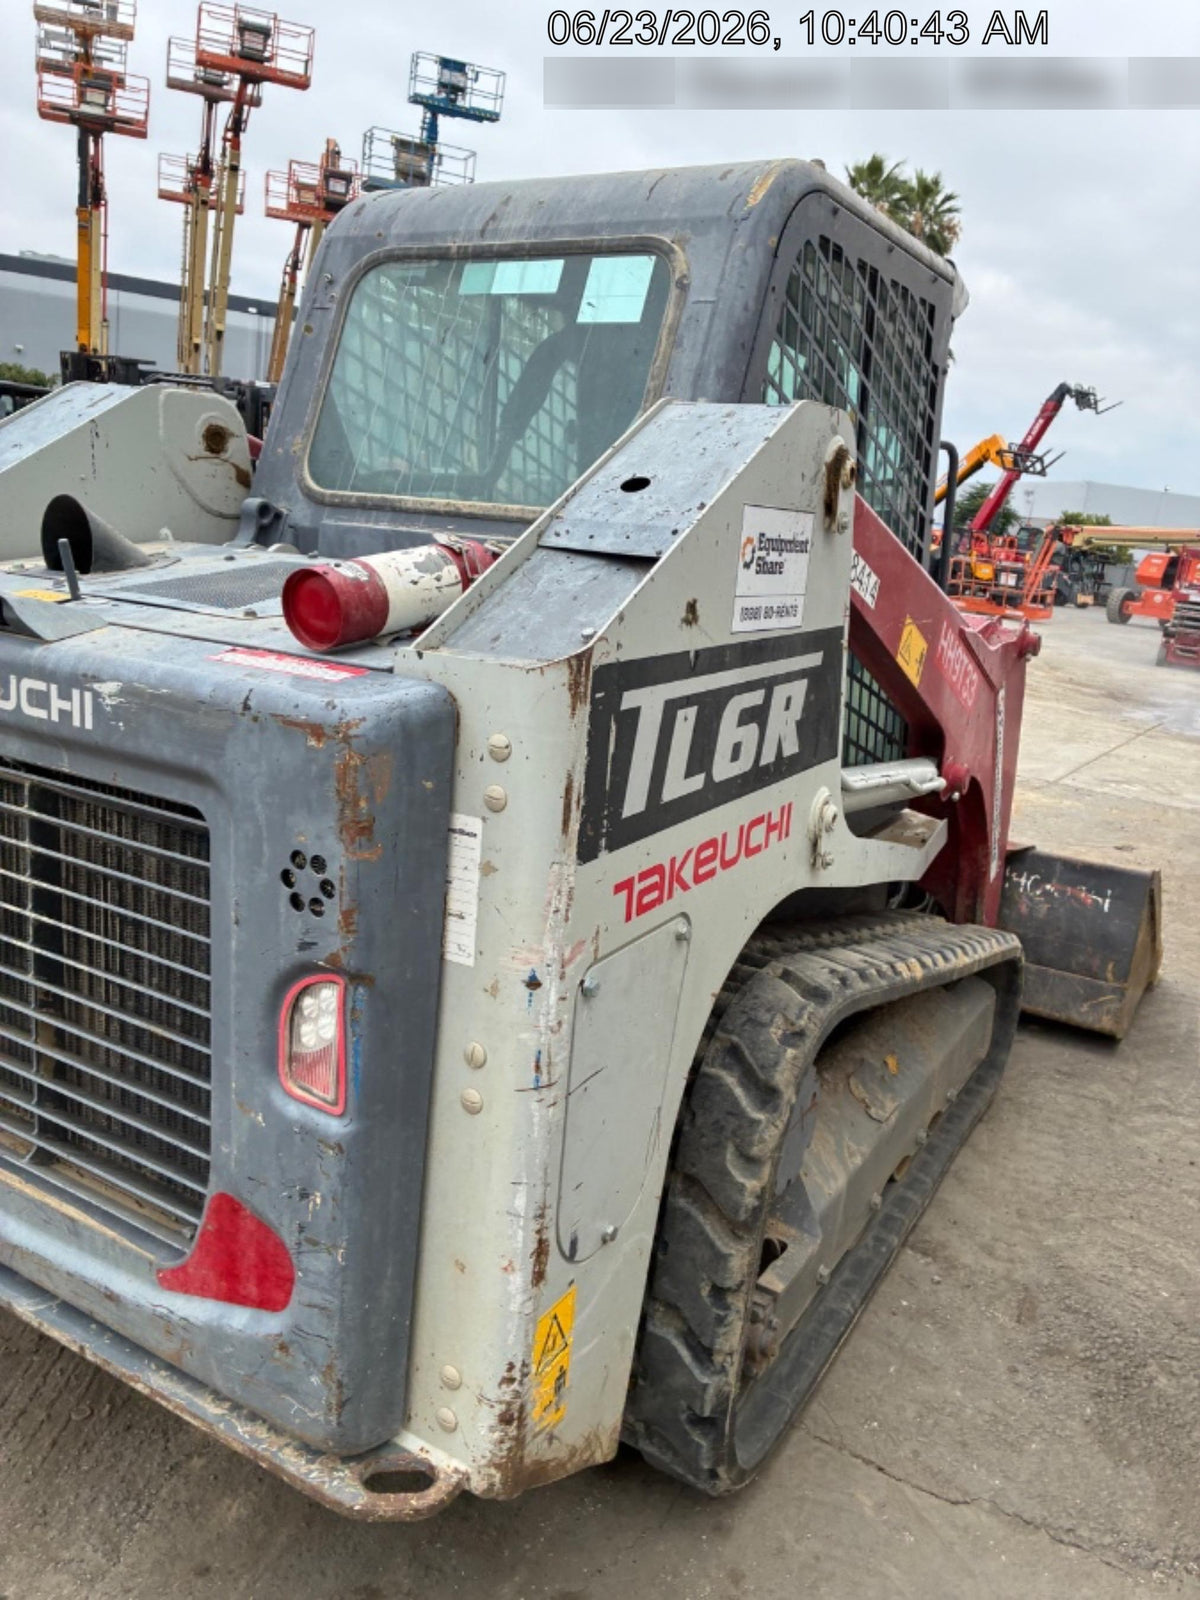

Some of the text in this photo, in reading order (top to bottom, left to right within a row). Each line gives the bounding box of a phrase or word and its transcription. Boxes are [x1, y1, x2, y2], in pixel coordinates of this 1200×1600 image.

[755, 556, 785, 575] Share
[757, 532, 810, 556] Equipment
[620, 651, 824, 819] TL6R
[613, 802, 794, 923] TAKEUCHI
